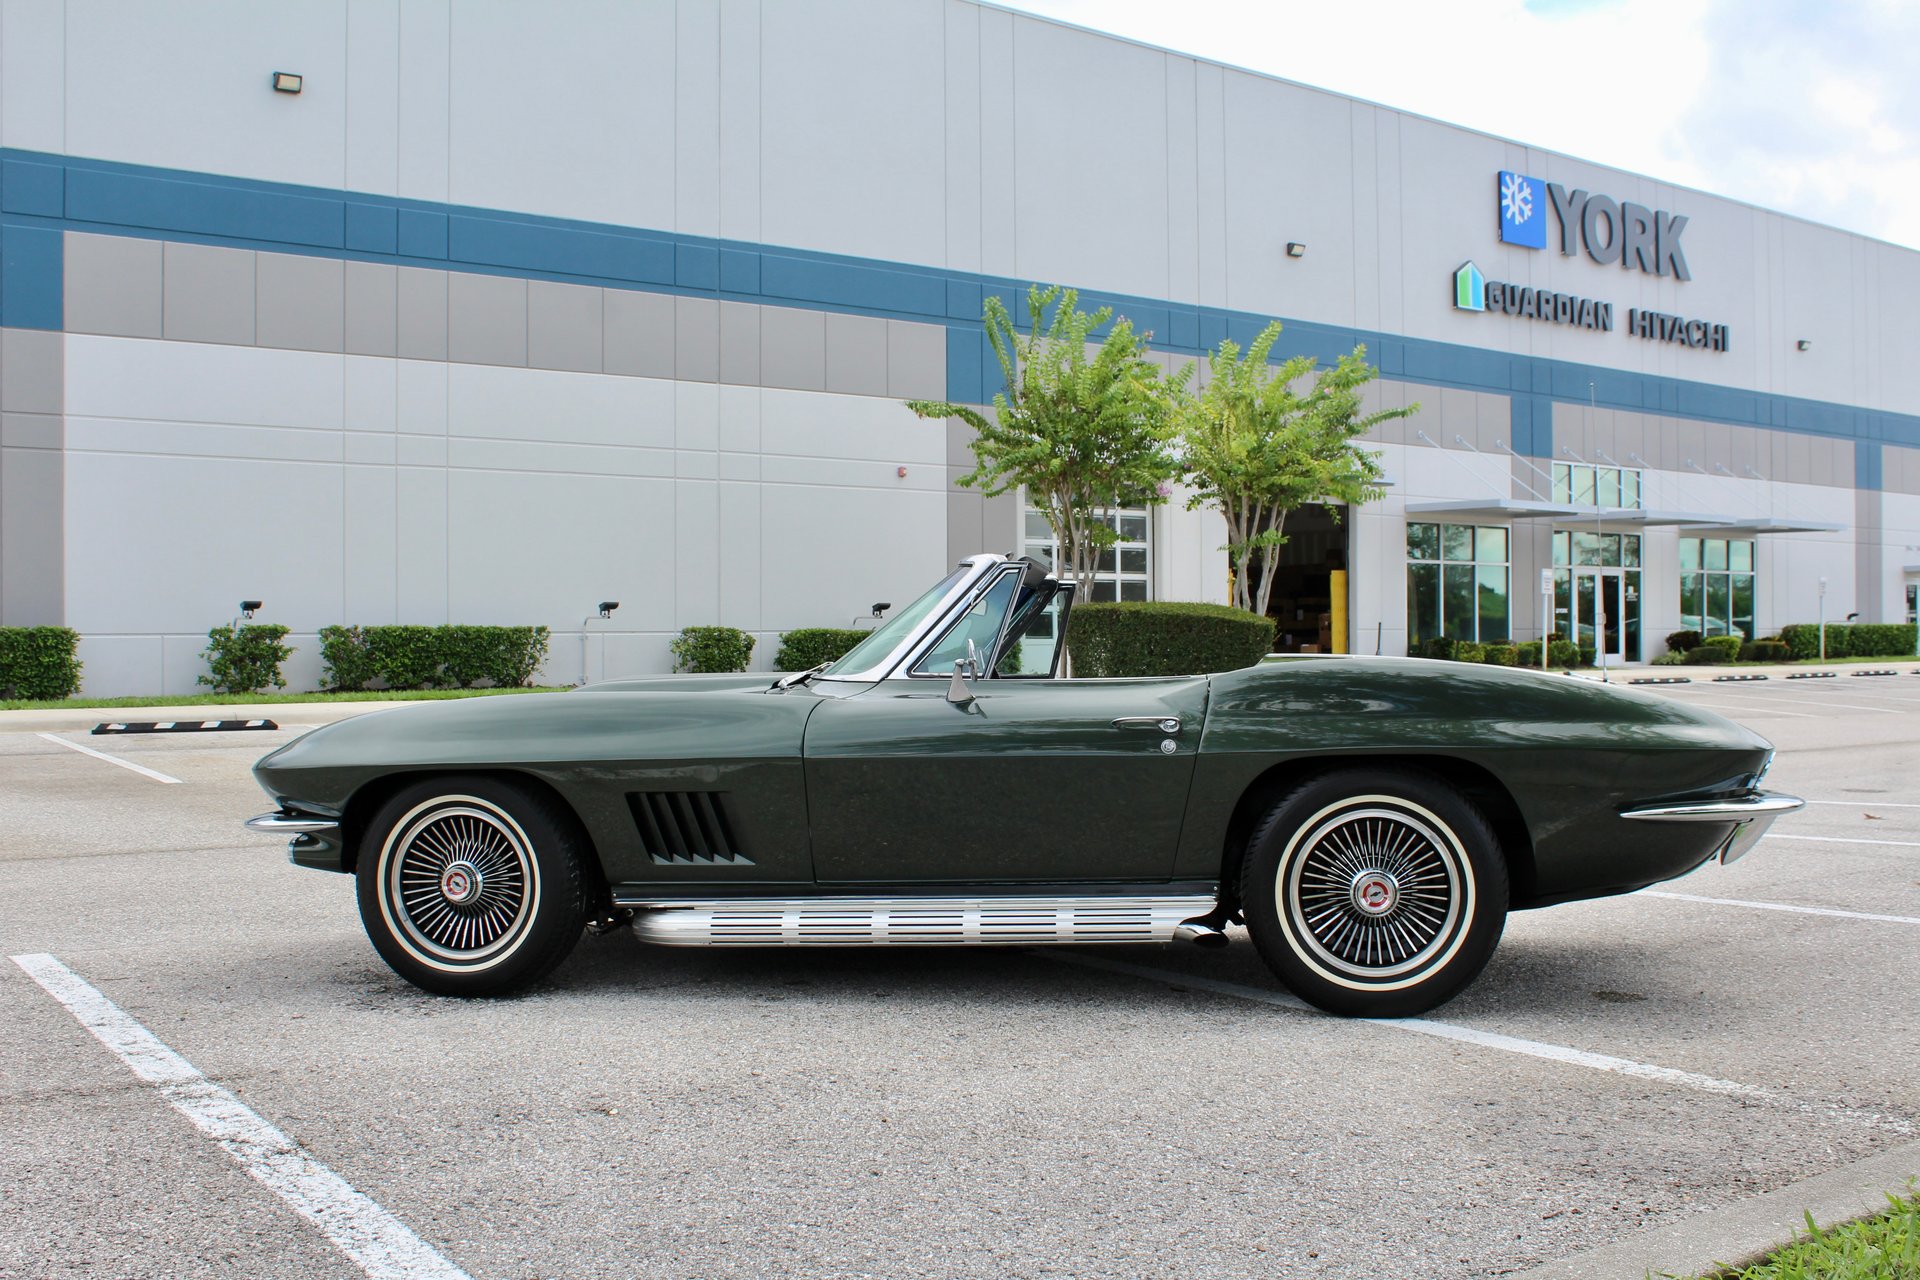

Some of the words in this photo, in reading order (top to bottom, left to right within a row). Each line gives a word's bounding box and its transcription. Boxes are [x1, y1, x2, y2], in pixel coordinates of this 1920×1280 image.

[1547, 182, 1691, 281] YORK
[1485, 281, 1613, 332] GUARDIAN
[1629, 308, 1729, 352] HITACHI
